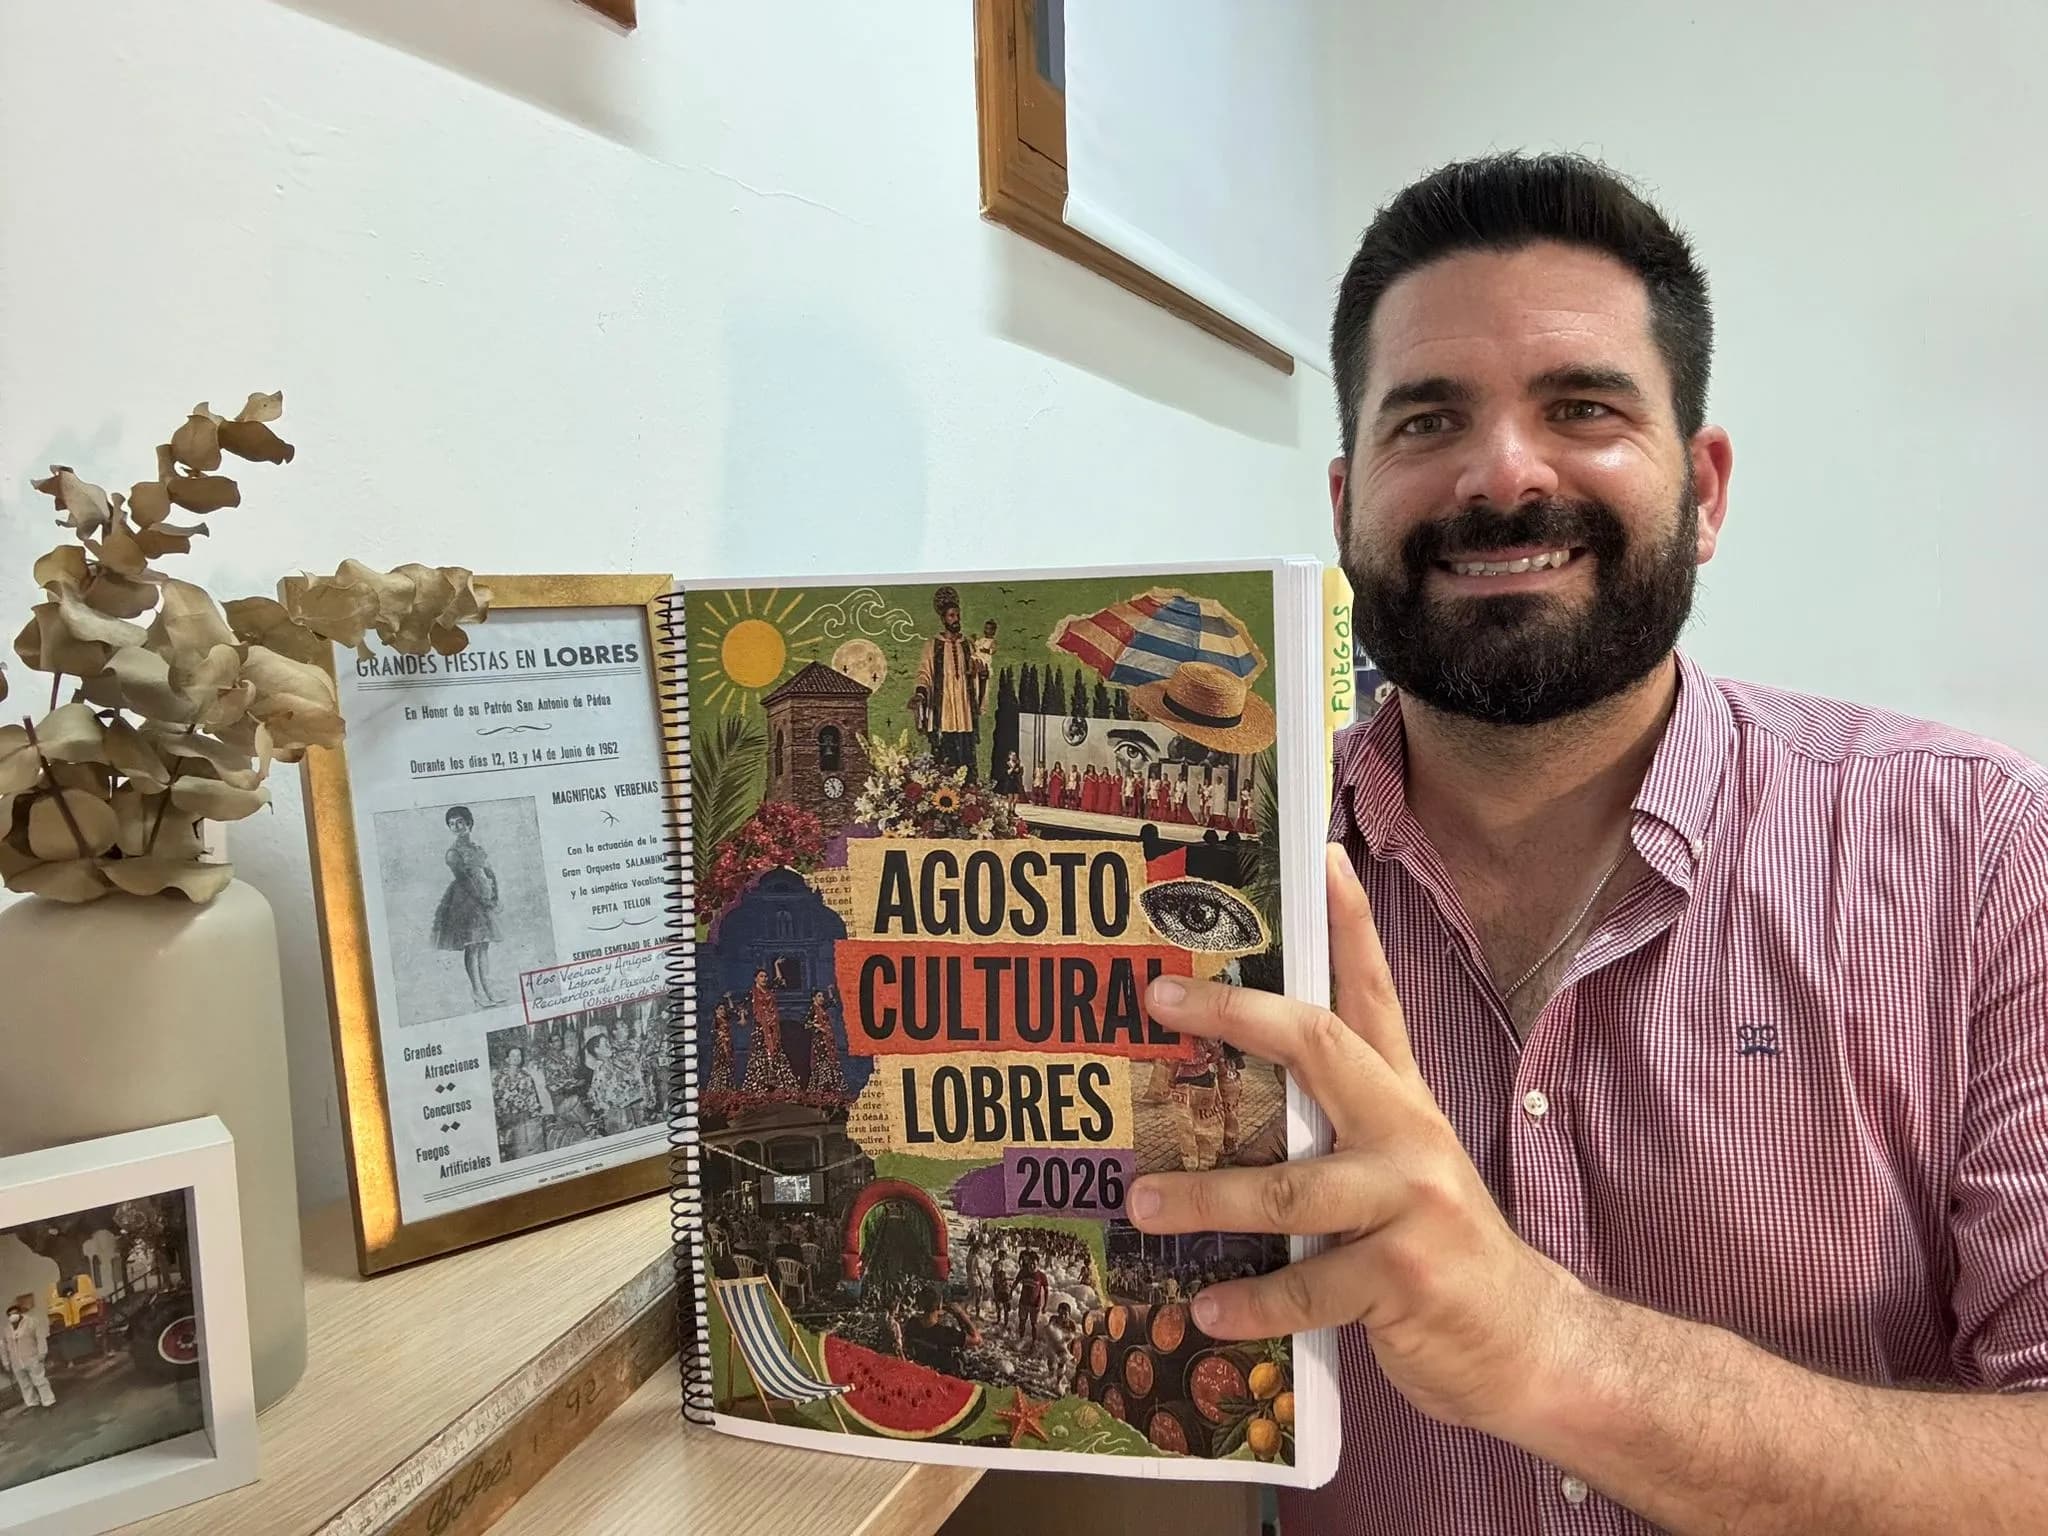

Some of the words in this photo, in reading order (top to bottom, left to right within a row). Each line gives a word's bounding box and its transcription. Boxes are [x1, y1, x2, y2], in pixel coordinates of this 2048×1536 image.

[357, 655, 437, 677] GRANDES
[444, 651, 508, 673] FIESTAS
[516, 650, 537, 669] EN
[544, 644, 640, 667] LOBRES
[1331, 605, 1351, 712] FUEGOS
[405, 707, 417, 720] En
[422, 704, 448, 719] Honor
[453, 704, 464, 717] de
[469, 705, 480, 717] su
[484, 701, 512, 715] Patrón
[517, 699, 534, 713] San
[538, 696, 569, 711] Antonio
[573, 696, 583, 708] de
[586, 693, 611, 707] Pádua
[410, 759, 446, 774] Durante
[450, 756, 465, 771] los
[492, 753, 505, 768] 12,
[508, 751, 519, 764] 13
[523, 752, 530, 766] y
[532, 749, 542, 762] 14
[546, 748, 557, 760] de
[561, 745, 582, 759] Junio
[585, 744, 596, 756] de
[599, 741, 619, 755] 1962
[552, 786, 607, 804] MAGNIFICAS
[614, 780, 659, 797] VERBENAS
[567, 845, 582, 855] Con
[586, 843, 594, 853] la
[597, 839, 633, 851] actuación
[637, 836, 647, 846] de
[650, 835, 657, 844] la
[562, 867, 581, 877] Gran
[586, 862, 621, 876] Orquesta
[571, 891, 576, 900] y
[579, 886, 588, 896] la
[591, 881, 628, 895] simpática
[631, 875, 665, 888] Vocalista
[873, 848, 1130, 937] AGOSTO
[592, 902, 618, 915] PEPITA
[624, 897, 651, 910] TELLON
[573, 949, 602, 962] SERVICIO
[643, 939, 651, 948] DE
[560, 965, 602, 982] Vecinos
[615, 954, 652, 975] Amigos
[532, 985, 594, 1010] Recuerdos
[620, 971, 660, 988] Pasado
[568, 975, 607, 990] Lobres
[403, 1043, 442, 1062] Grandes
[425, 1057, 480, 1080] Atracciones
[423, 1100, 472, 1120] Concursos
[902, 1062, 1115, 1144] LOBRES
[416, 1143, 450, 1163] Fuegos
[440, 1155, 491, 1179] Artificiales
[1016, 1156, 1125, 1209] 2026
